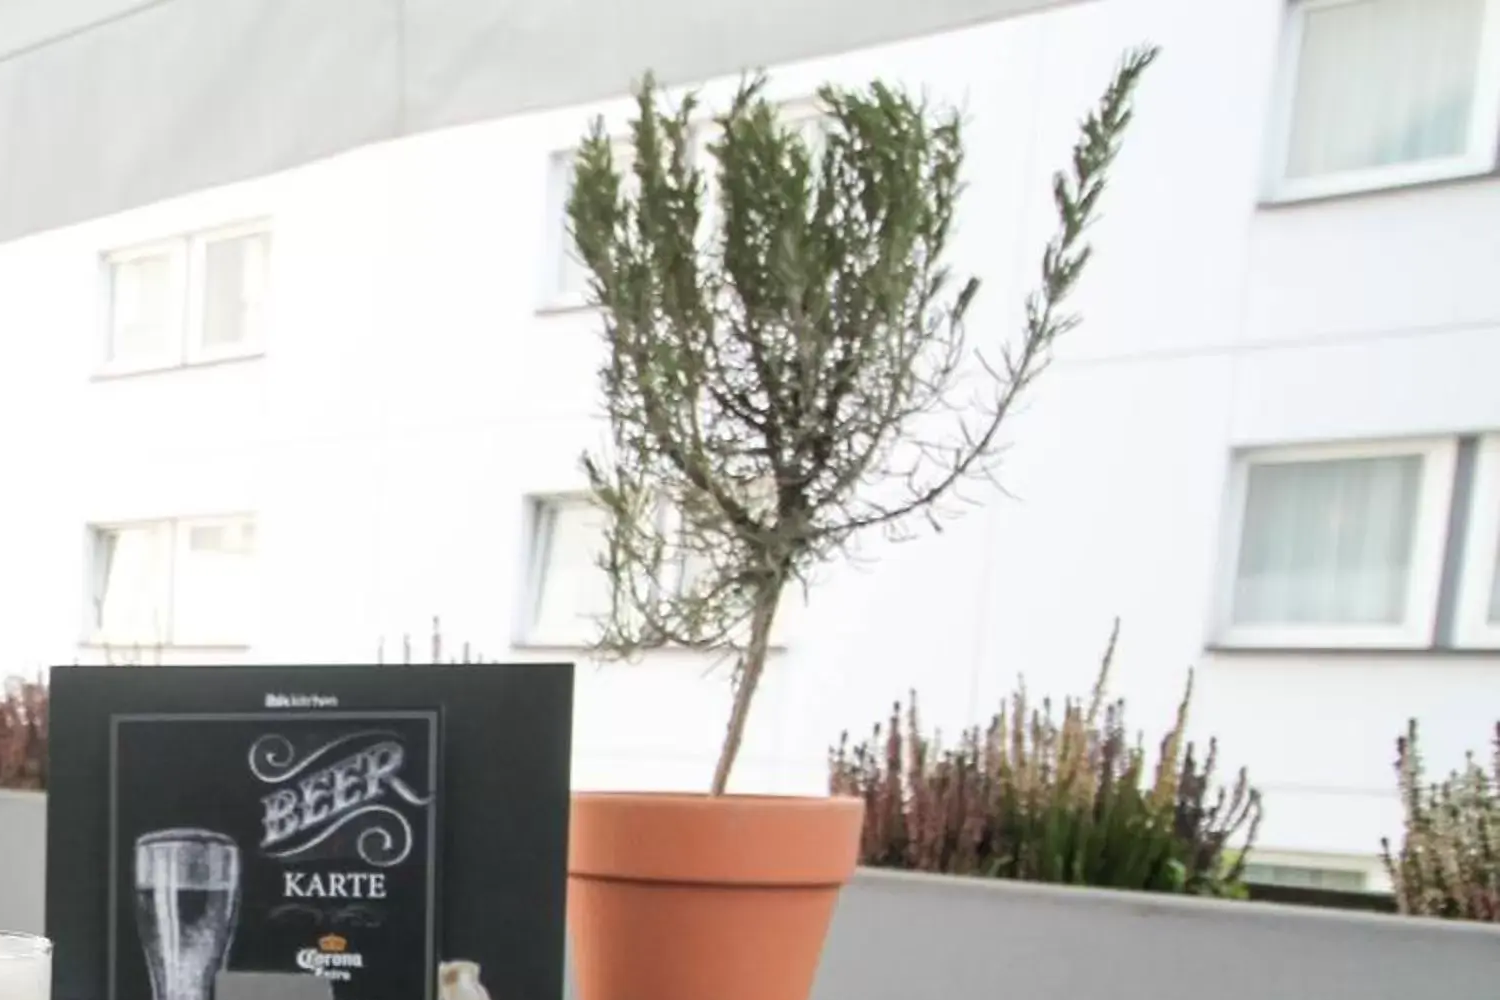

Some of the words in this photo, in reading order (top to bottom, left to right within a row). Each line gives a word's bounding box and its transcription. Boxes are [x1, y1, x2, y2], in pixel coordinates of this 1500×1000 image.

[259, 741, 435, 848] BEER
[283, 872, 387, 899] KARTE
[296, 947, 363, 969] Corona
